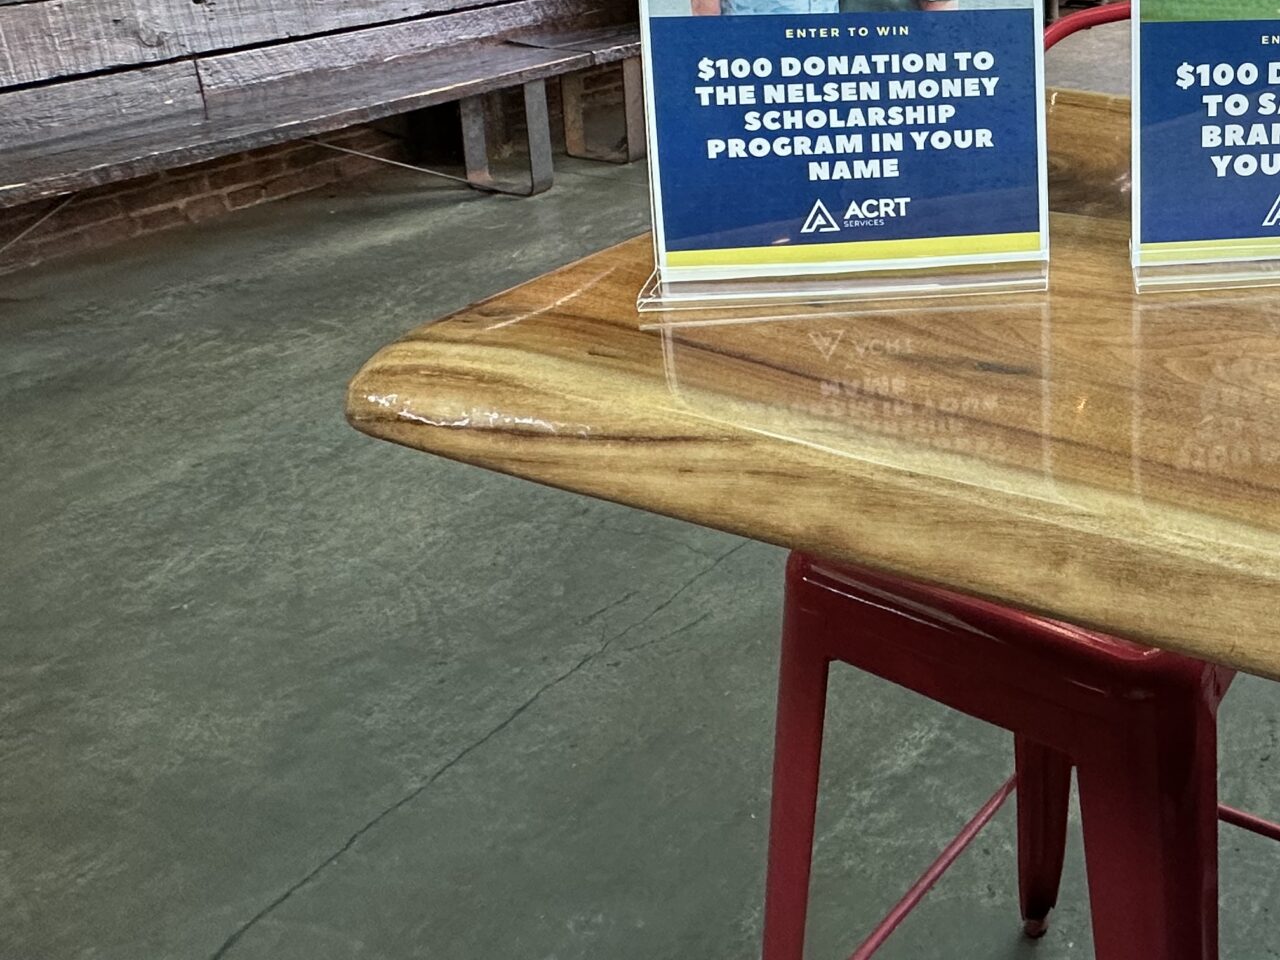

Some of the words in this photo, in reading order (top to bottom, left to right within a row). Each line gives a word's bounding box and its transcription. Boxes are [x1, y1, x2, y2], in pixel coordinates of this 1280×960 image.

[785, 28, 840, 38] ENTER
[848, 27, 868, 37] TO
[876, 26, 909, 36] WIN
[697, 57, 773, 82] $100
[780, 52, 947, 76] DONATION
[953, 51, 995, 71] TO
[1175, 62, 1259, 90] $100
[694, 85, 757, 106] THE
[763, 79, 881, 104] NELSEN
[888, 77, 1000, 100] MONEY
[744, 104, 956, 131] SCHOLARSHIP
[1202, 94, 1250, 117] TO
[707, 134, 863, 159] PROGRAM
[871, 132, 904, 153] IN
[909, 128, 994, 151] YOUR
[808, 157, 900, 181] NAME
[844, 197, 911, 218] ACRT
[843, 218, 885, 228] SERVICES
